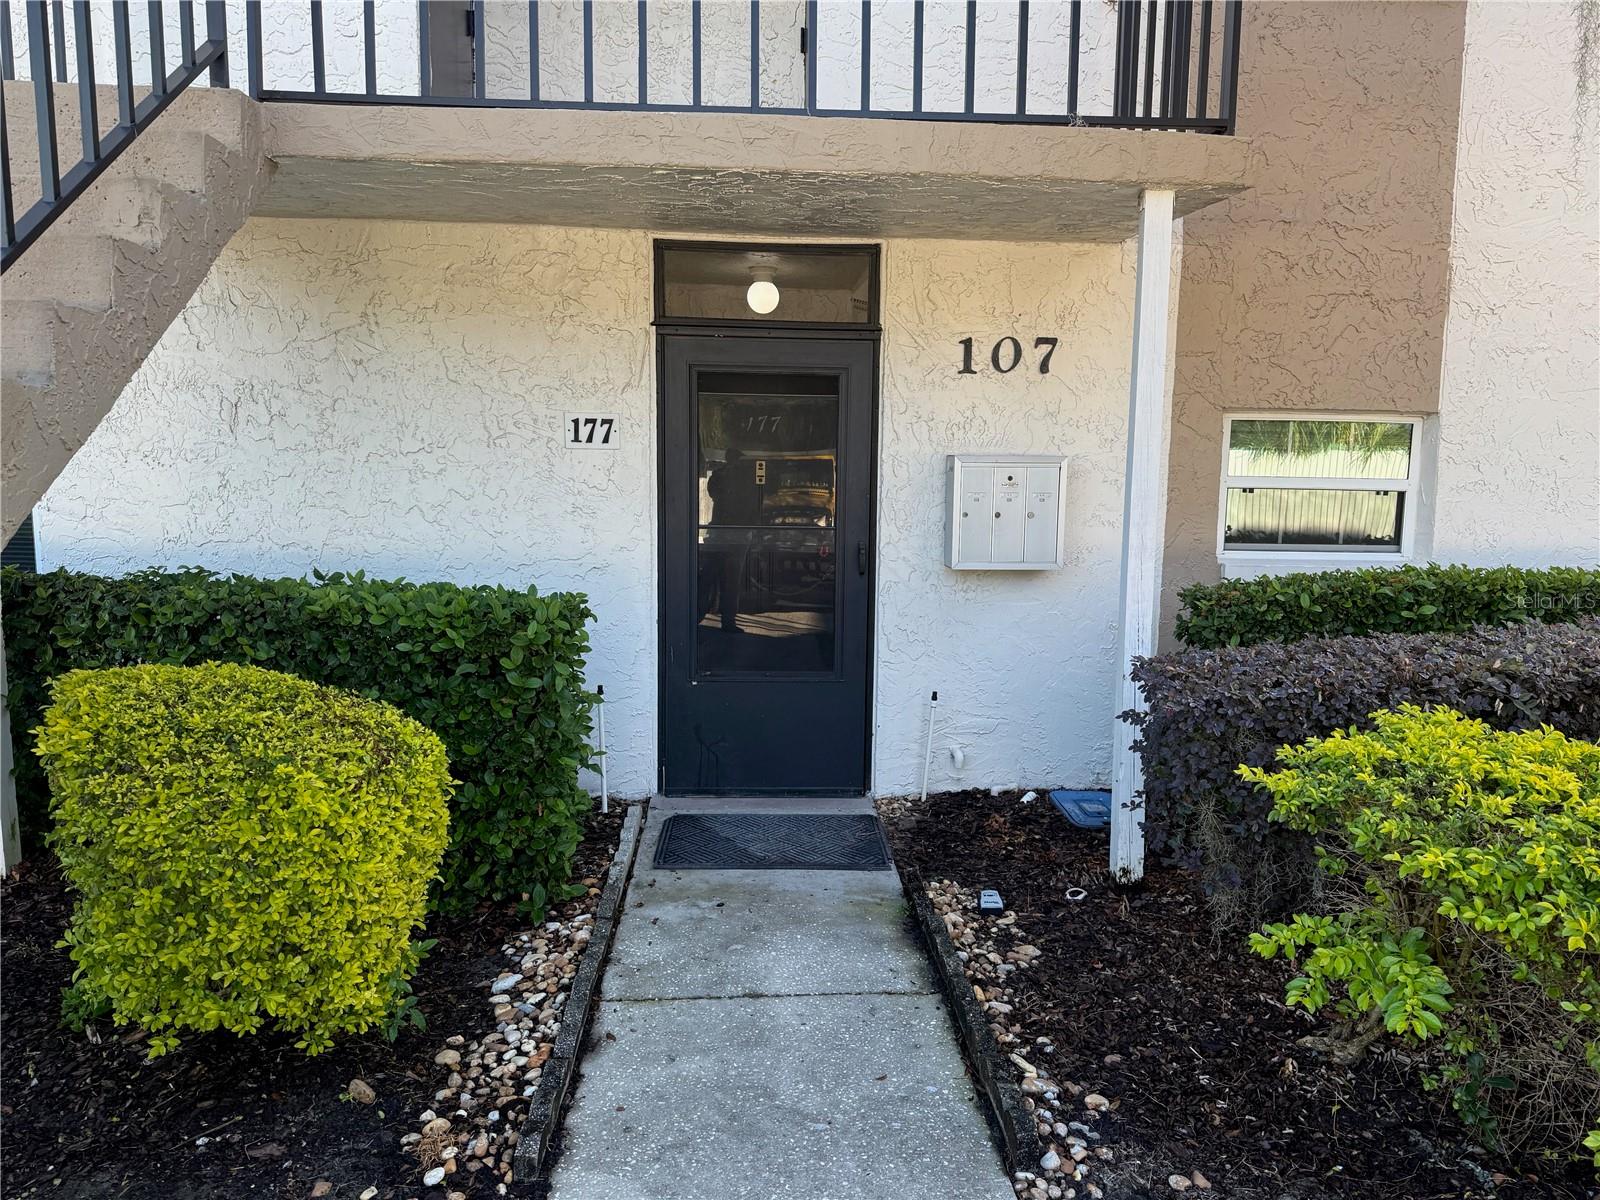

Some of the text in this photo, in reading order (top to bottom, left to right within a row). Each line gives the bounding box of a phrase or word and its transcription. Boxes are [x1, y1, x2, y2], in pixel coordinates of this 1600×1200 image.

[957, 336, 1058, 375] 107
[571, 417, 614, 444] 177
[746, 415, 782, 433] 177
